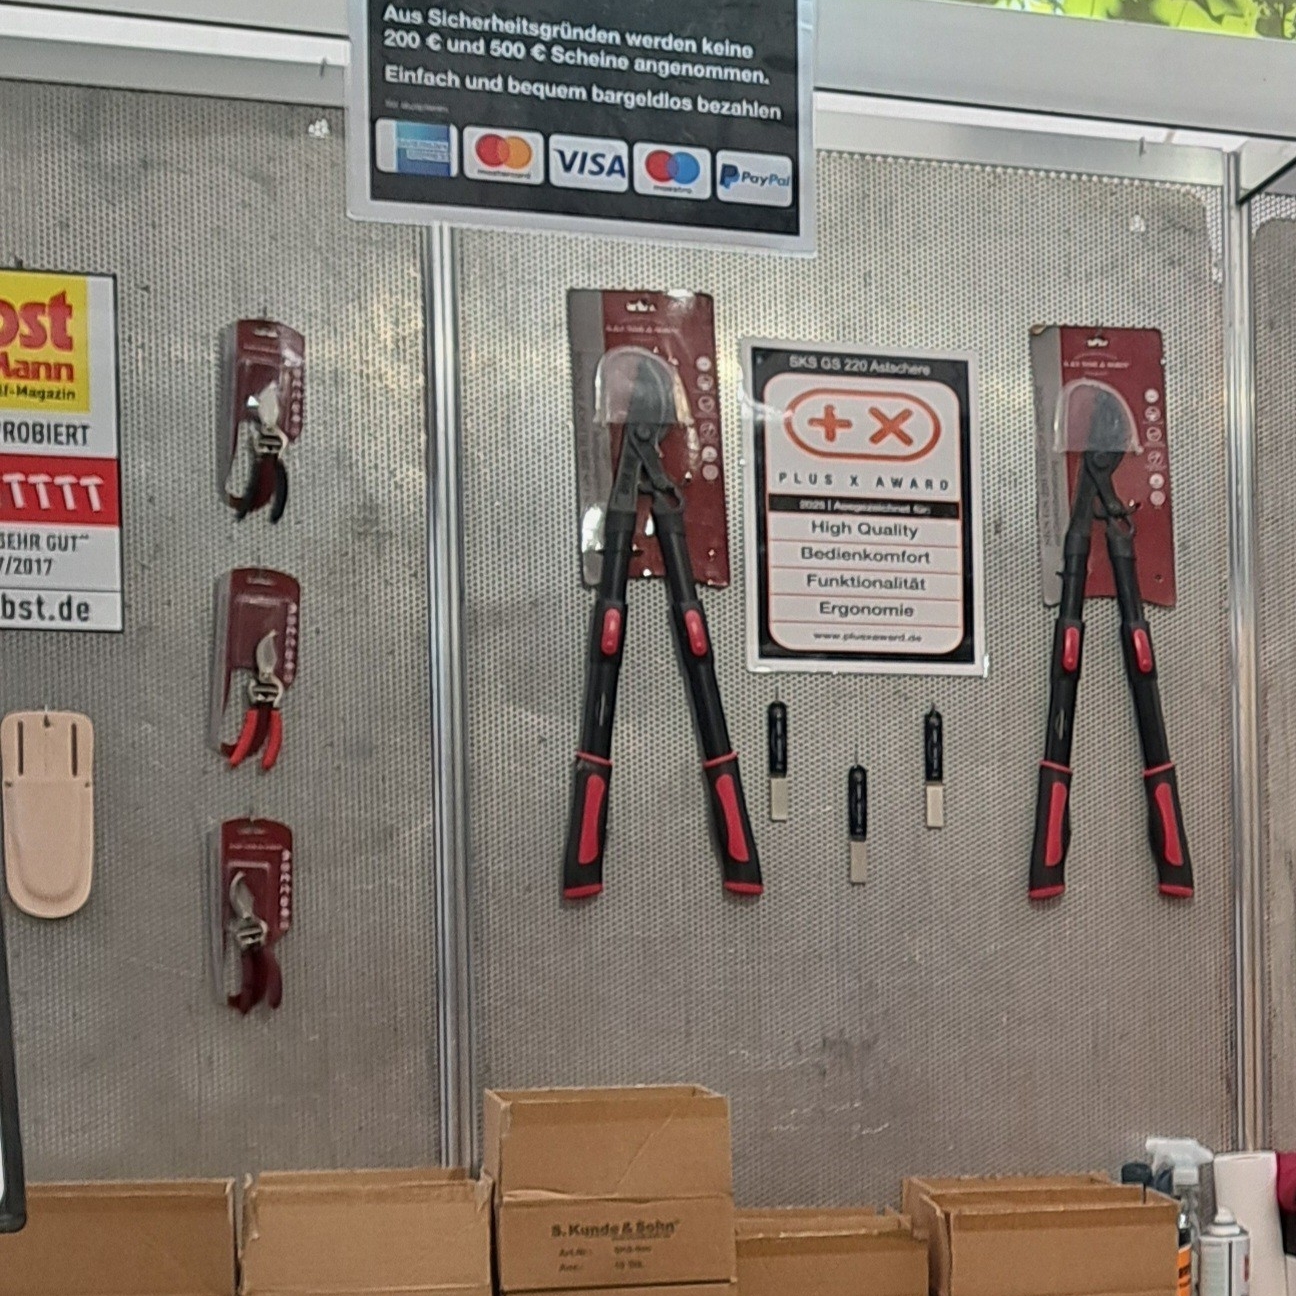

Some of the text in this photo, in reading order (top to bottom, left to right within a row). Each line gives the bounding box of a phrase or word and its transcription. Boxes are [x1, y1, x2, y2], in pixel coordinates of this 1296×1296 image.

[382, 4, 754, 59] Aus Sicherheitsgründen werden keine
[383, 29, 771, 85] 200 € und 500 € Scheine angenommen.
[384, 64, 782, 120] Einfach und bequem bargeldlos bezahlen
[553, 148, 626, 178] VISA
[741, 171, 790, 188] PayPal
[844, 358, 868, 372] 220
[0, 421, 90, 446] ROBIERT
[778, 472, 950, 492] PLUS X AWARD
[811, 520, 918, 540] High Quality
[801, 546, 931, 564] Bedienkomfort
[806, 573, 926, 591] Funktionalität
[819, 601, 914, 618] Ergonomie
